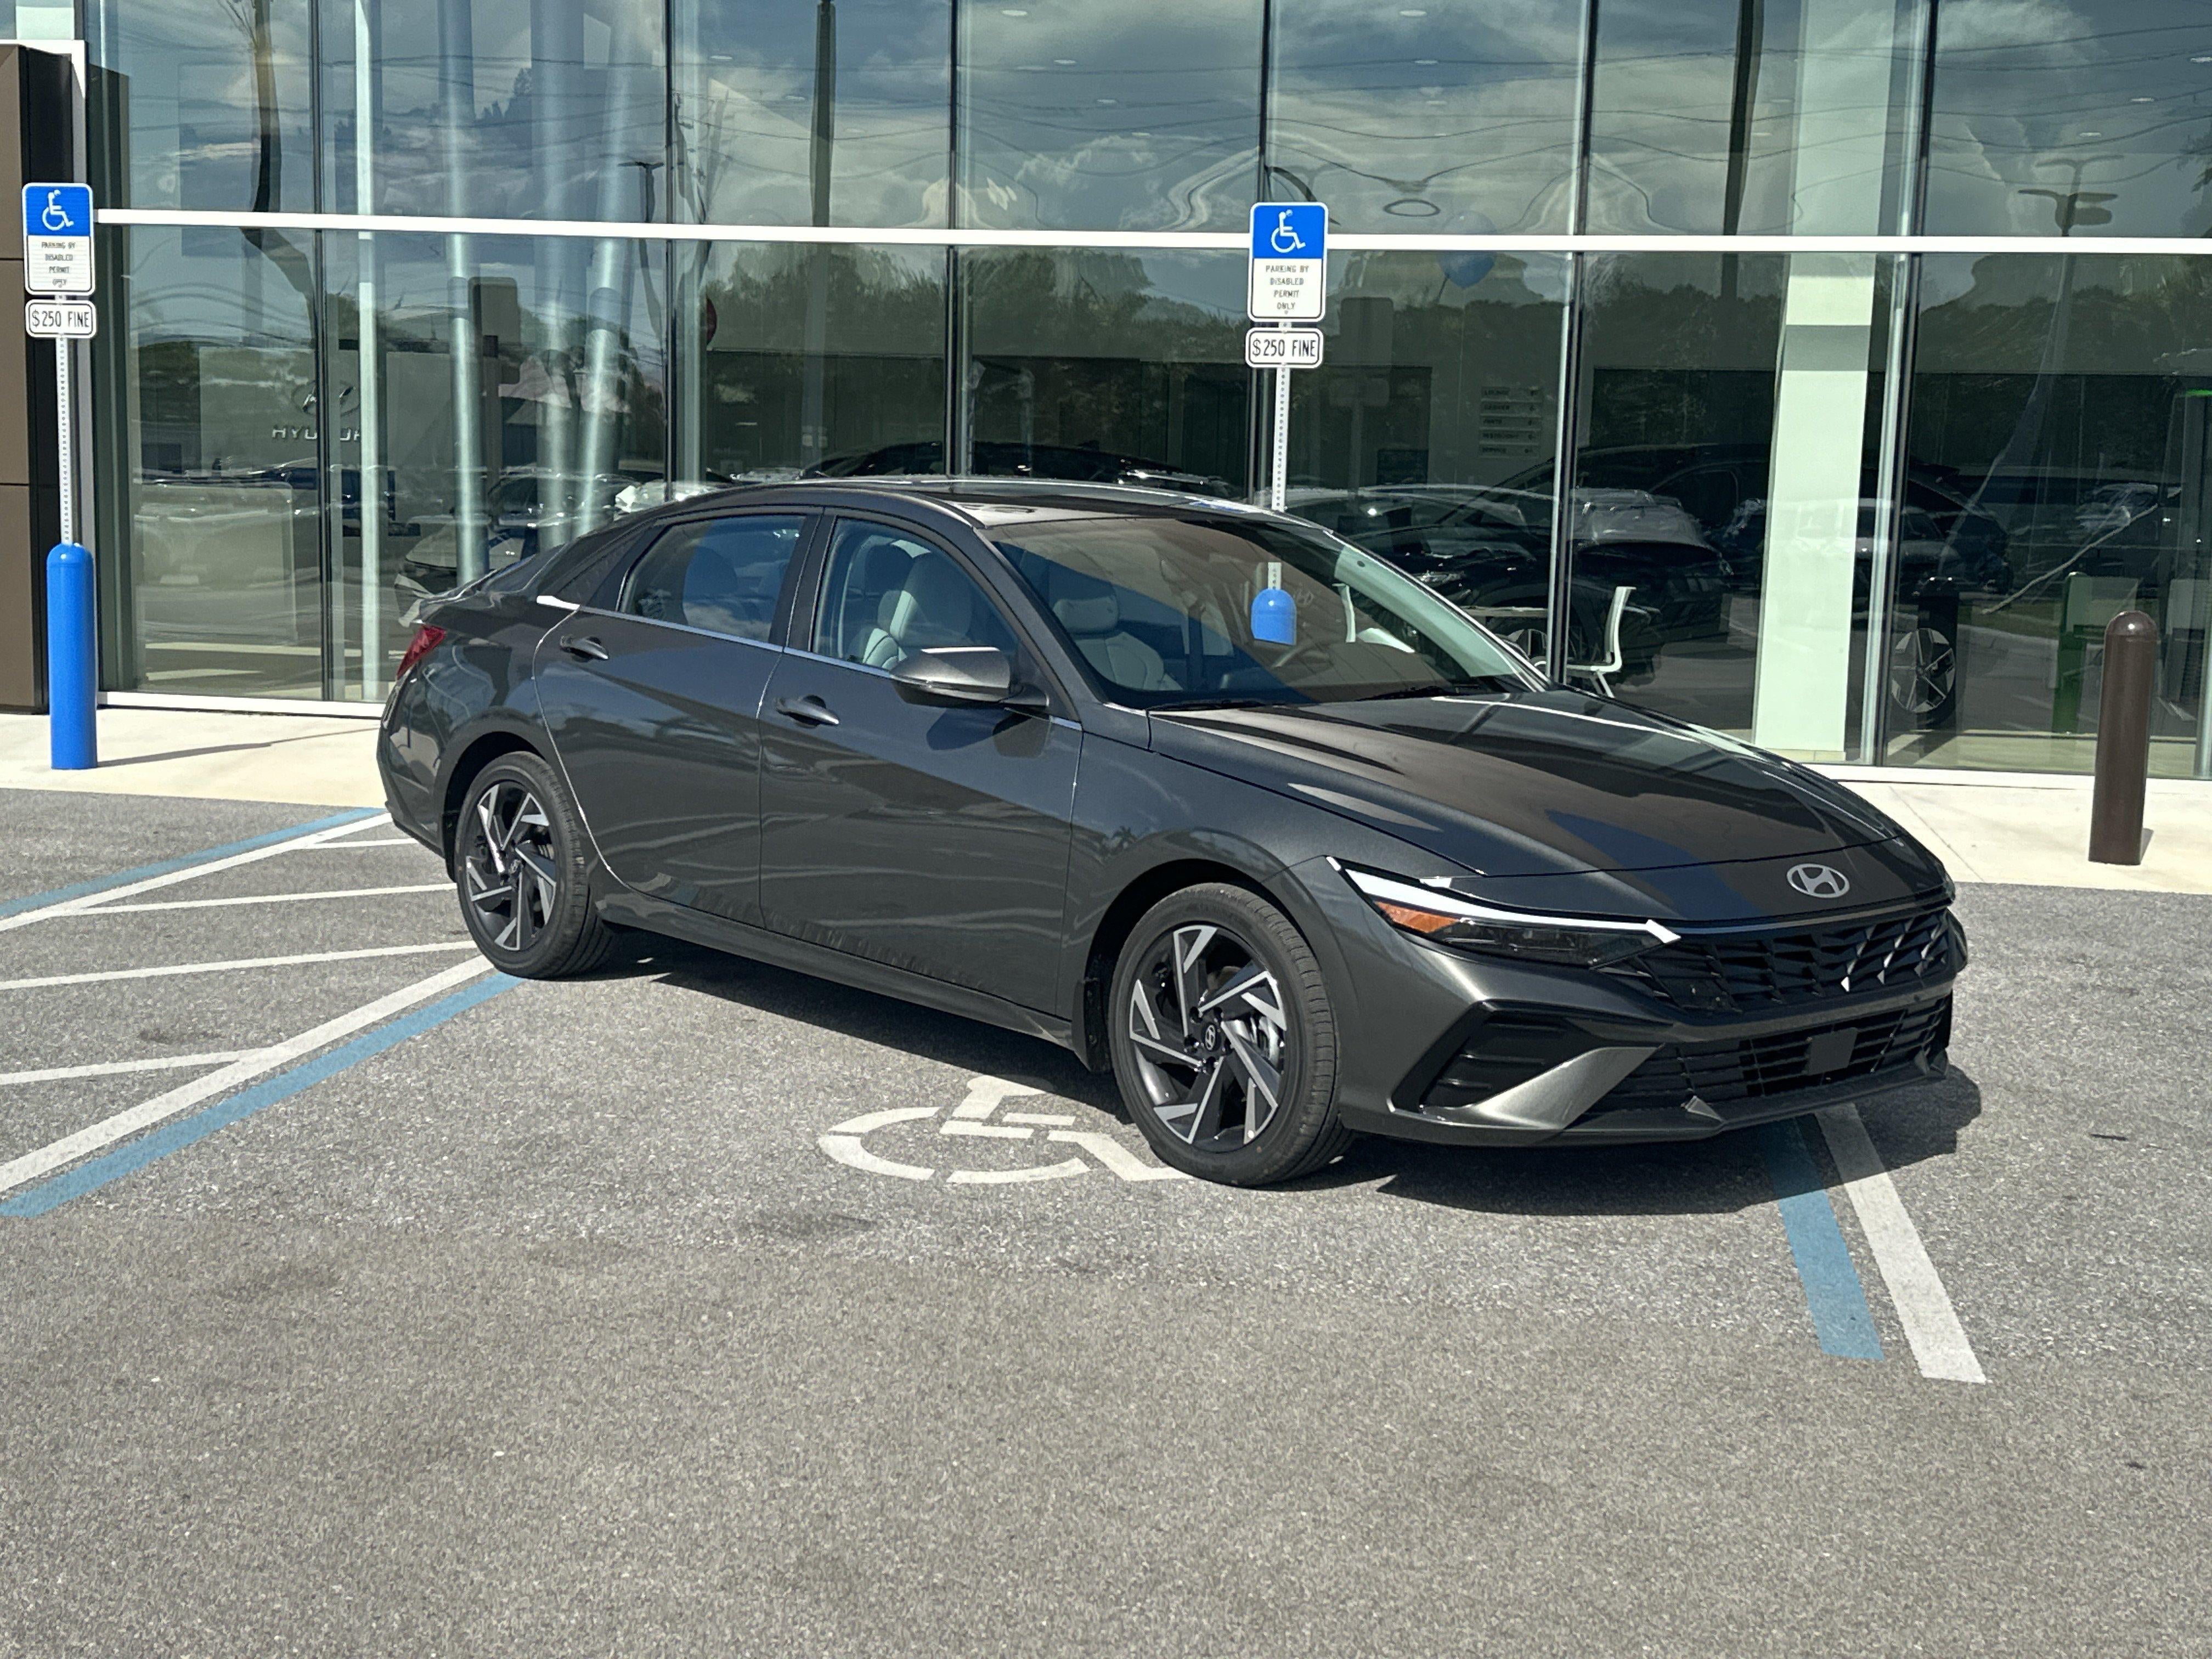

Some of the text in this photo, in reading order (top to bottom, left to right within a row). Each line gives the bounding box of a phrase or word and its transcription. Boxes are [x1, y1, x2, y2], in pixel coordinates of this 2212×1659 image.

[1269, 278, 1305, 286] DISABLED
[1273, 290, 1300, 298] PERMIT
[32, 309, 90, 328] $250 FINE
[1252, 338, 1317, 357] $250 FINE
[271, 425, 360, 442] HYUD
